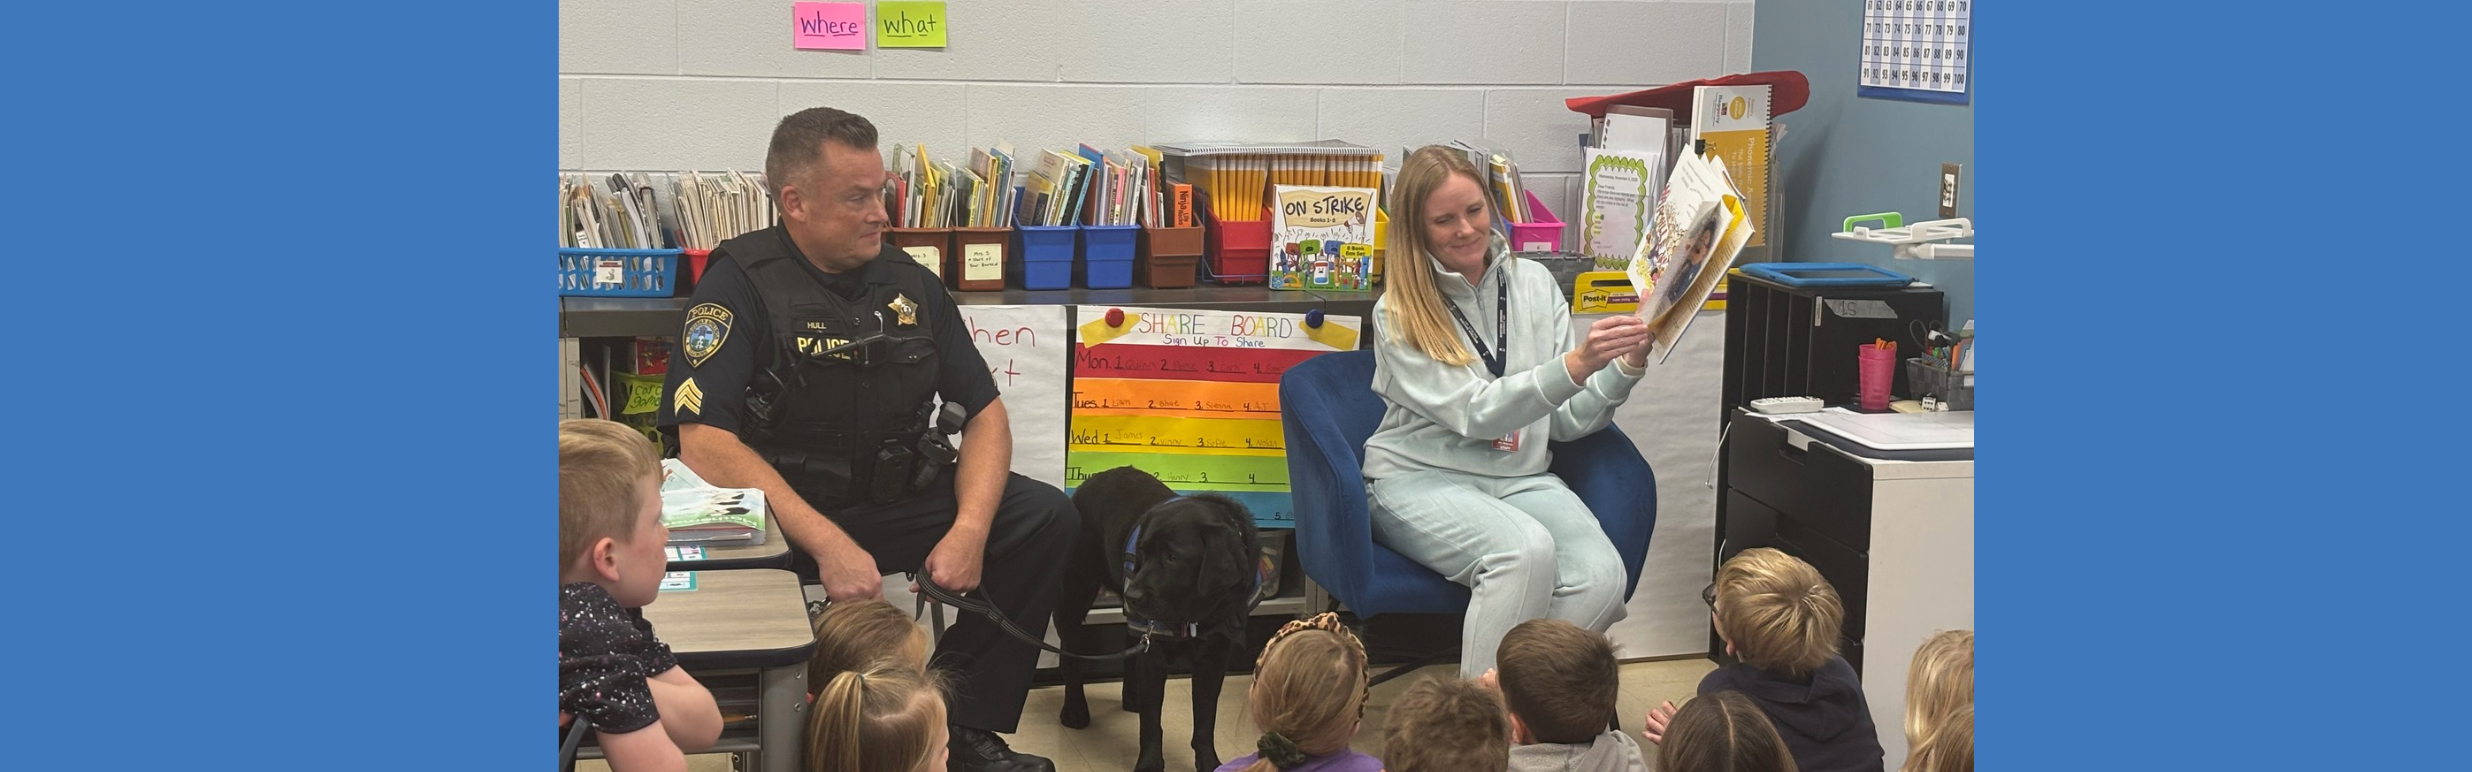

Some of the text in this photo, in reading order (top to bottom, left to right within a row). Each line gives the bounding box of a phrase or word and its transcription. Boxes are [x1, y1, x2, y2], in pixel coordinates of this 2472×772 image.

[1867, 0, 1967, 12] 61 62 63 64 65 66 67 68 69 70
[801, 10, 858, 34] where
[884, 10, 936, 33] what
[1866, 23, 1965, 36] 71 72 73 74 75 76 77 78 79 80
[1865, 45, 1964, 60] 81 82 83 84 85 86 87 88 89 90
[1863, 68, 1964, 84] 91 92 93 94 95 96 97 98 99 100
[1746, 137, 1755, 184] Phonemic
[1178, 190, 1189, 210] Ninja
[1285, 195, 1364, 216] ON STRIKE
[1583, 295, 1607, 303] Post-it
[692, 307, 728, 320] POLICE
[969, 316, 1035, 347] hen
[1139, 312, 1292, 338] SHARE BOARD
[1163, 333, 1265, 347] Sign Up To Share
[1076, 350, 1111, 369] Mon.
[1254, 402, 1269, 410] AJ
[1115, 429, 1143, 439] James
[1256, 439, 1278, 447] Nolan
[1167, 472, 1189, 482] Henry
